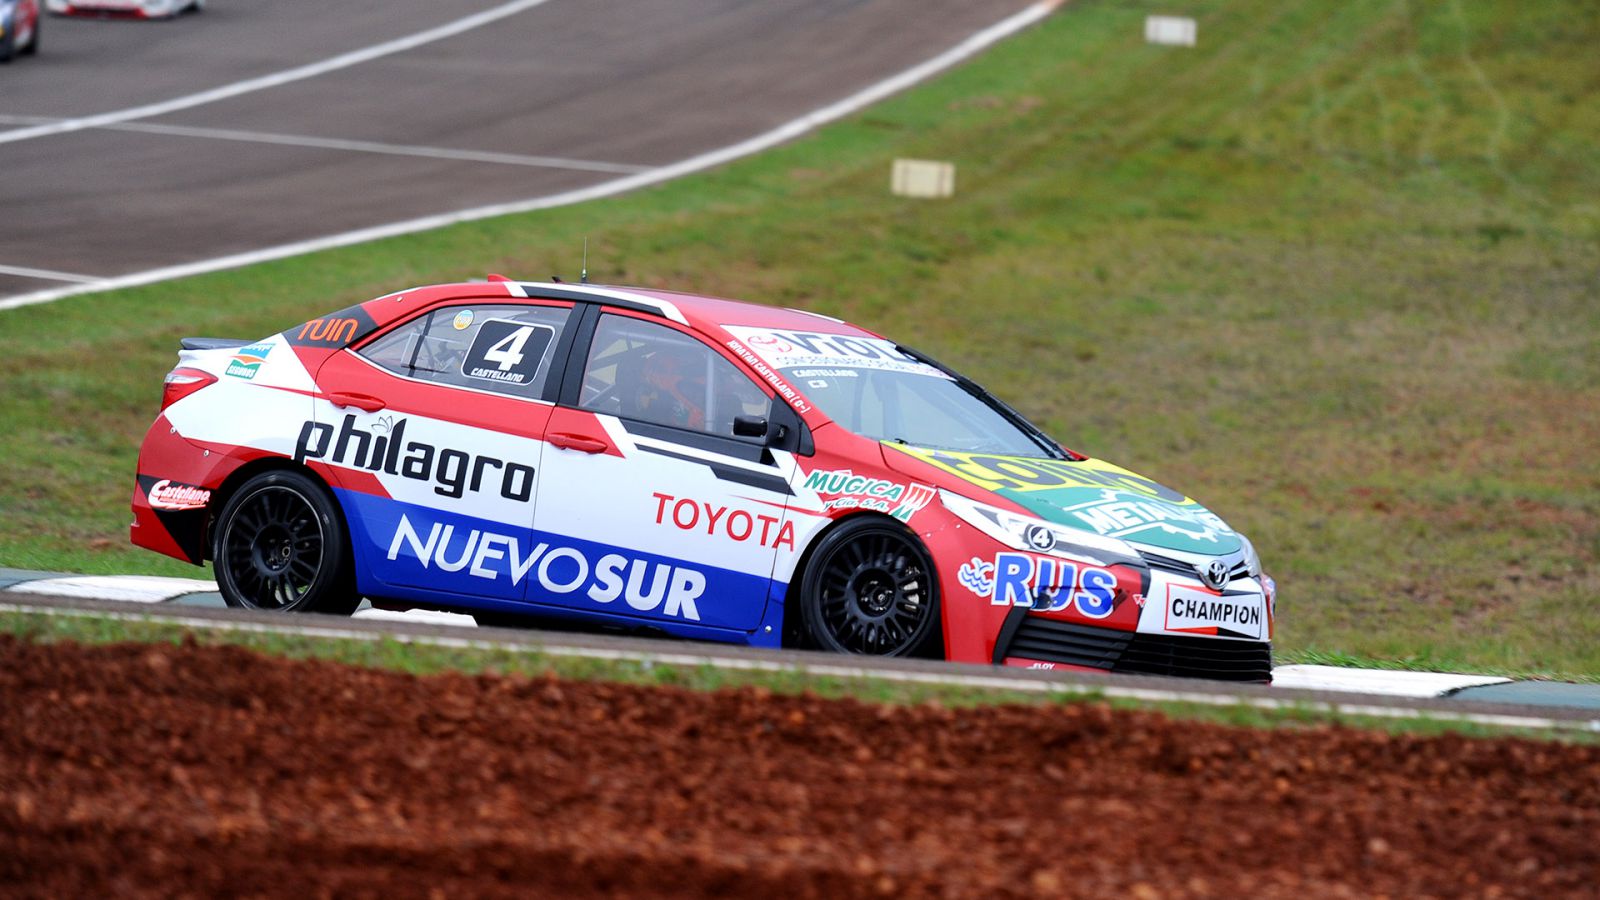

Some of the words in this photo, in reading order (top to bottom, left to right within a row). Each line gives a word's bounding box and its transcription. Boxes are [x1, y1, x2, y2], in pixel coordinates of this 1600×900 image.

[484, 326, 535, 371] 4
[471, 368, 525, 382] CASTELLANO
[754, 362, 795, 398] CASTELLANO
[294, 414, 536, 503] philagro
[148, 479, 211, 509] Castellano
[863, 500, 888, 511] S.A.
[652, 492, 795, 552] TOYOTA
[1033, 528, 1050, 547] 4
[992, 553, 1116, 617] RUS
[1173, 598, 1260, 625] CHAMPION
